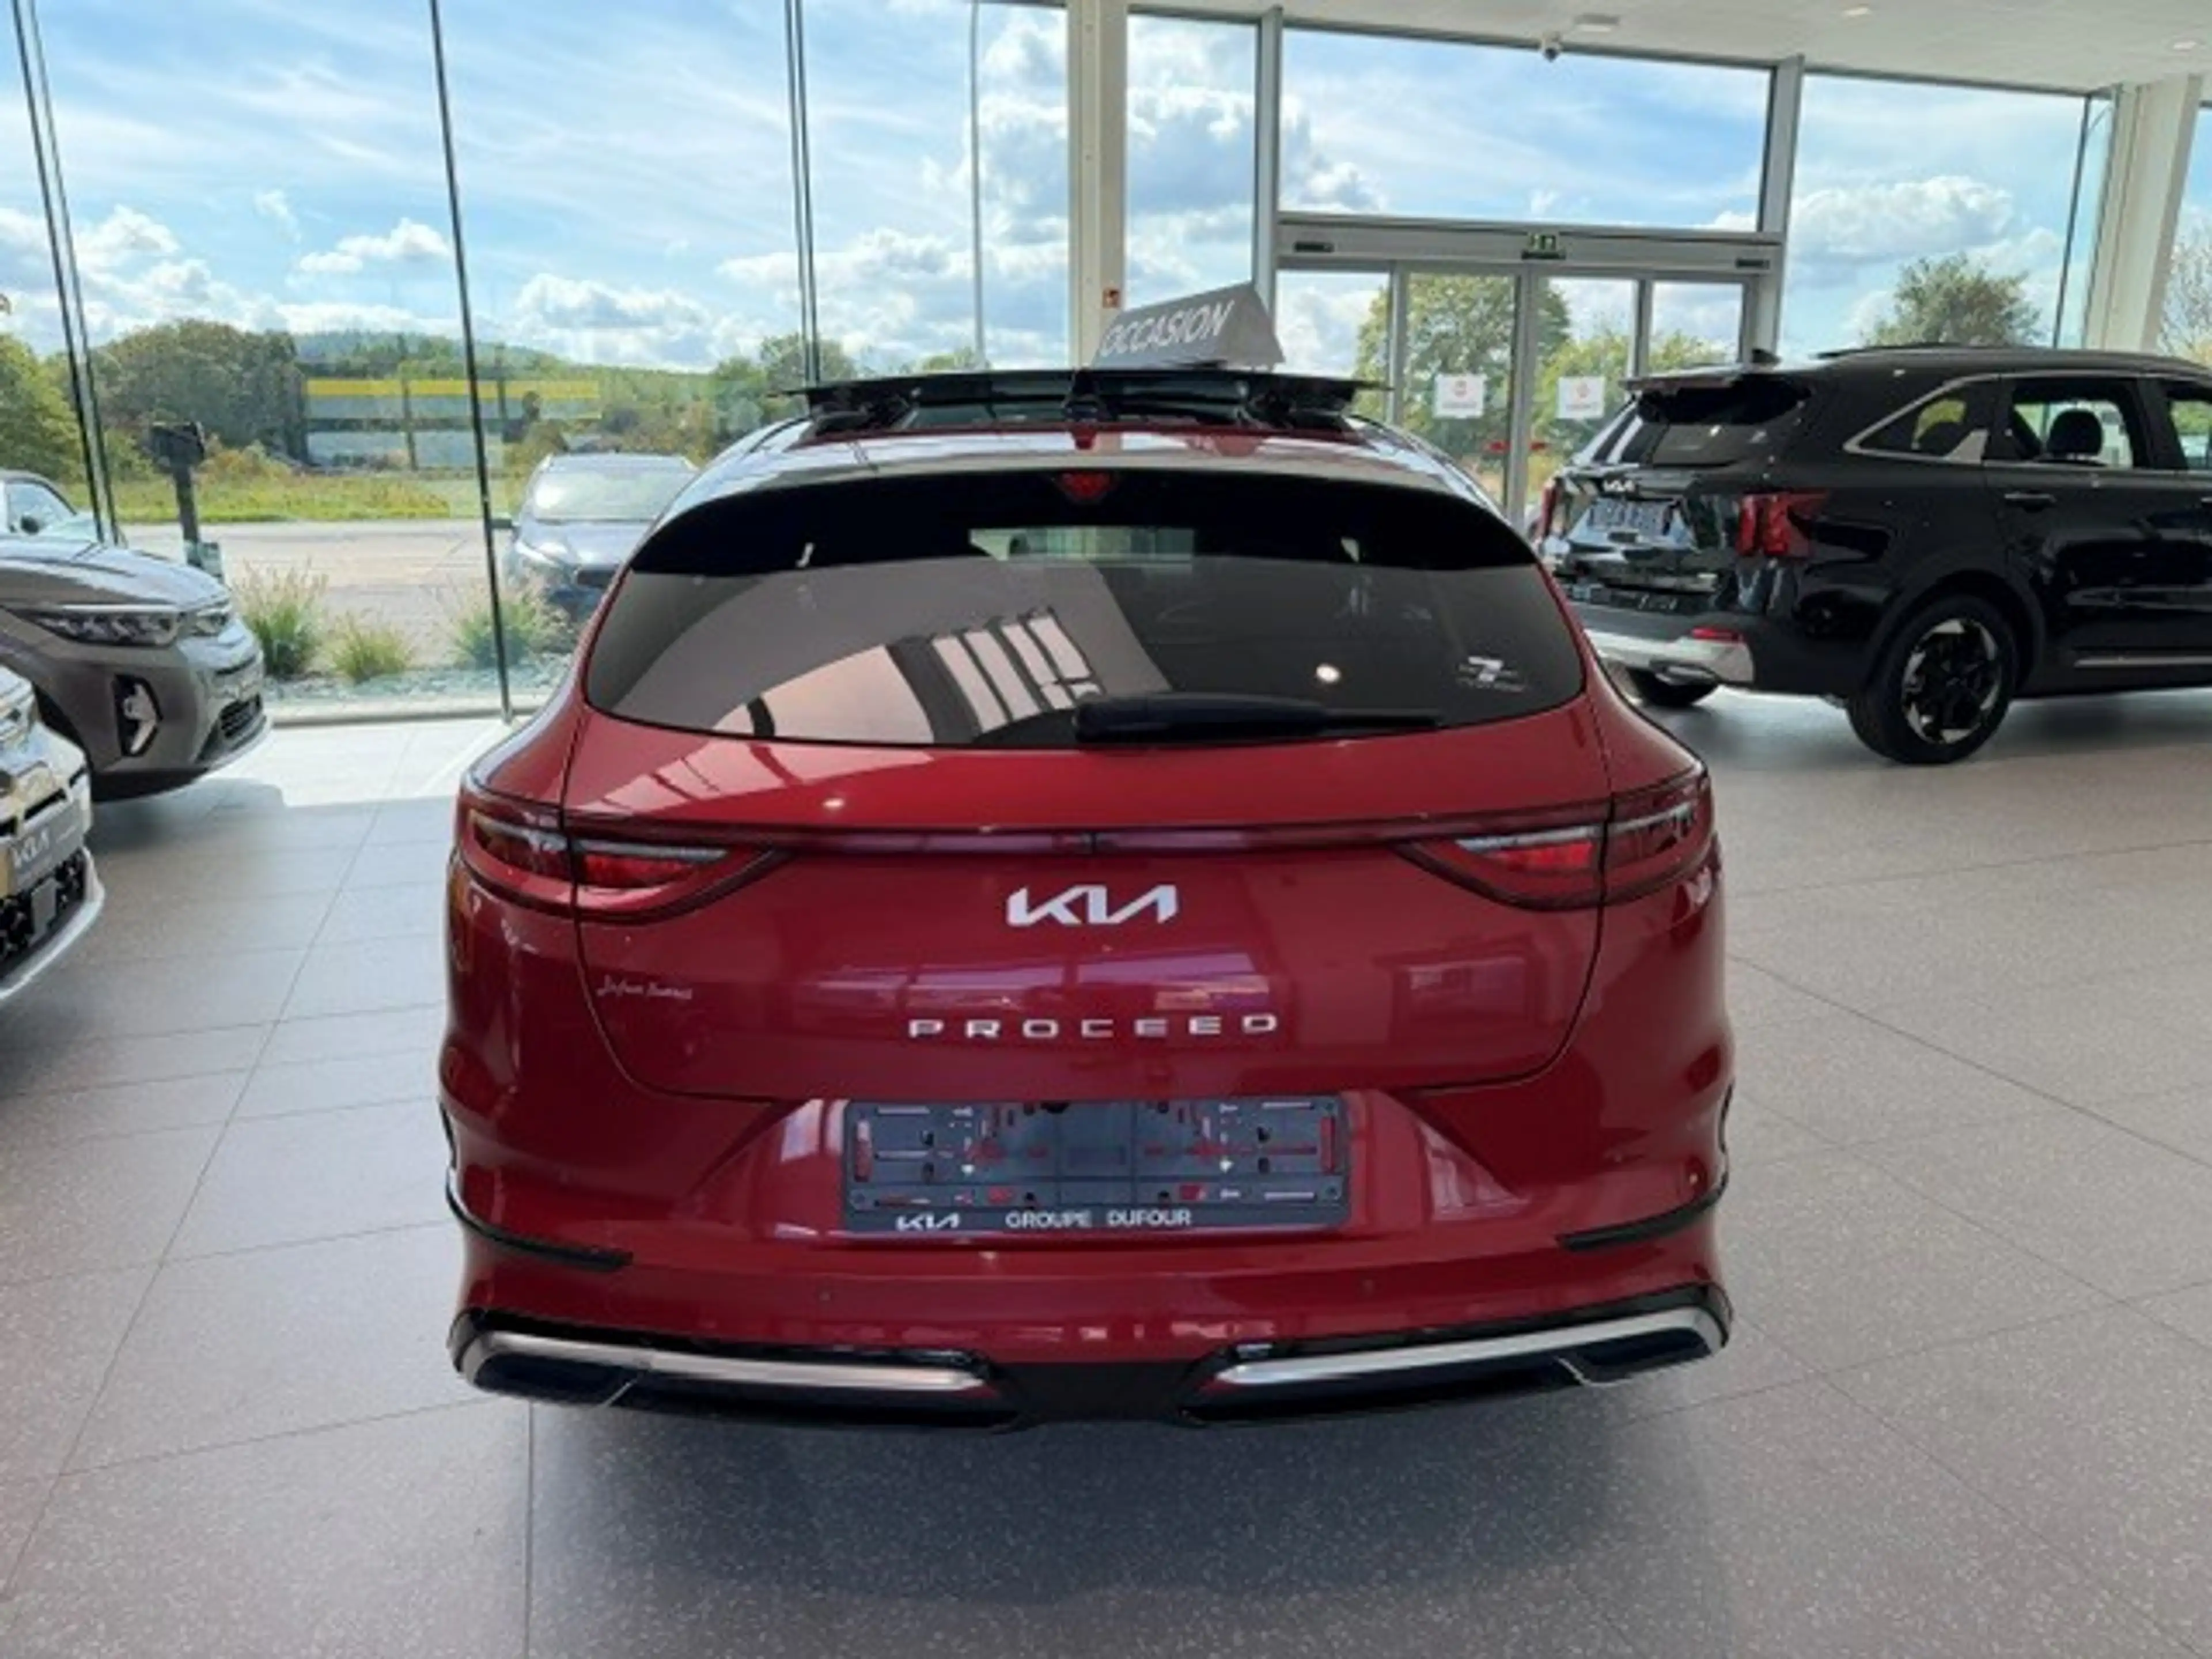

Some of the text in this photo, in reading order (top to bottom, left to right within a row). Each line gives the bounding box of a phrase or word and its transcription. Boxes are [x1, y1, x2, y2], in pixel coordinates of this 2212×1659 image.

[1101, 298, 1236, 357] OCCASION
[1006, 885, 1177, 925] KIA
[908, 1014, 1278, 1037] PROCEED
[895, 1209, 1192, 1231] KIA GROUPE DUFOUR
